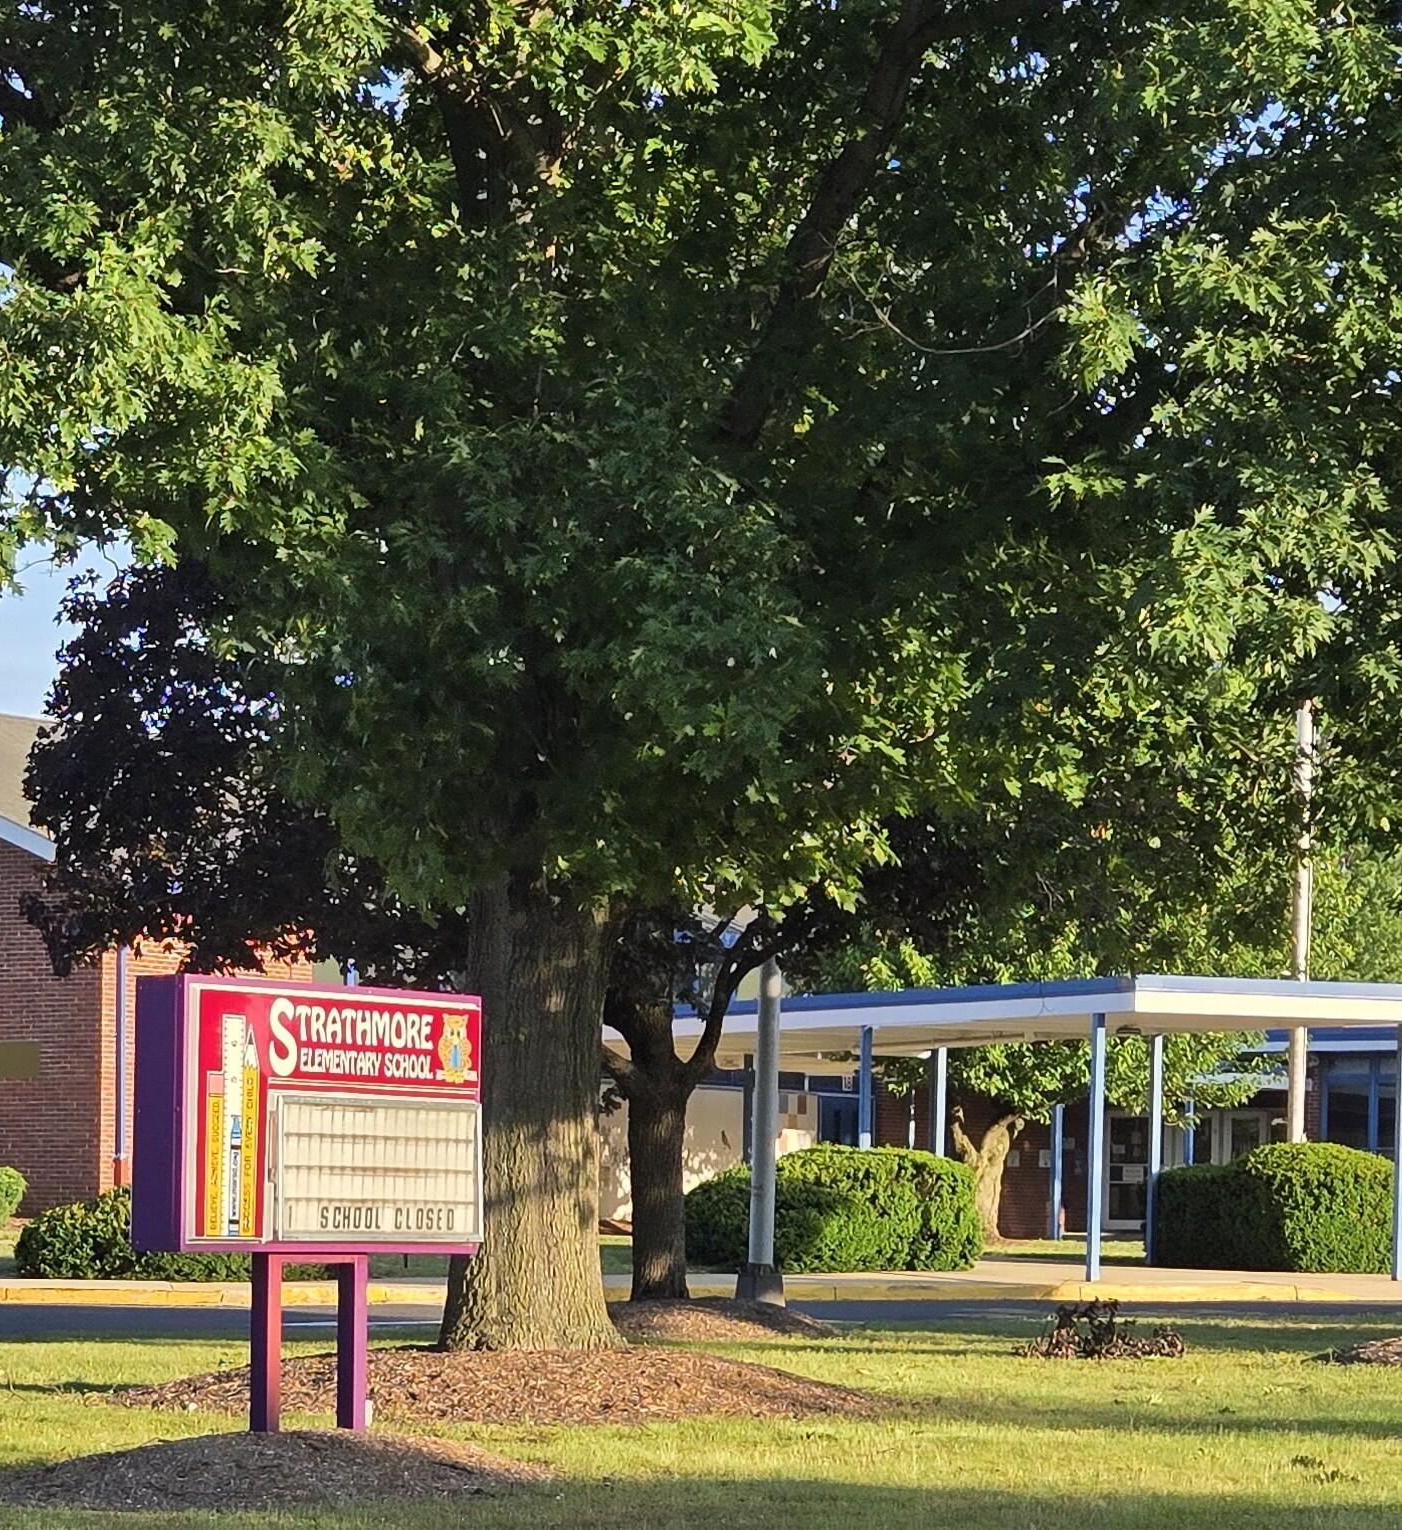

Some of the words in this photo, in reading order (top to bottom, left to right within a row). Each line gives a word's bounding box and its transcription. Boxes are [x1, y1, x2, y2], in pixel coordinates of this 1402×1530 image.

[269, 997, 434, 1076] STRATHMORE
[300, 1048, 382, 1077] ELEMENTARY
[384, 1053, 434, 1080] SCHOOL
[320, 1206, 381, 1230] SCHOOL
[394, 1207, 455, 1231] CLOSED
